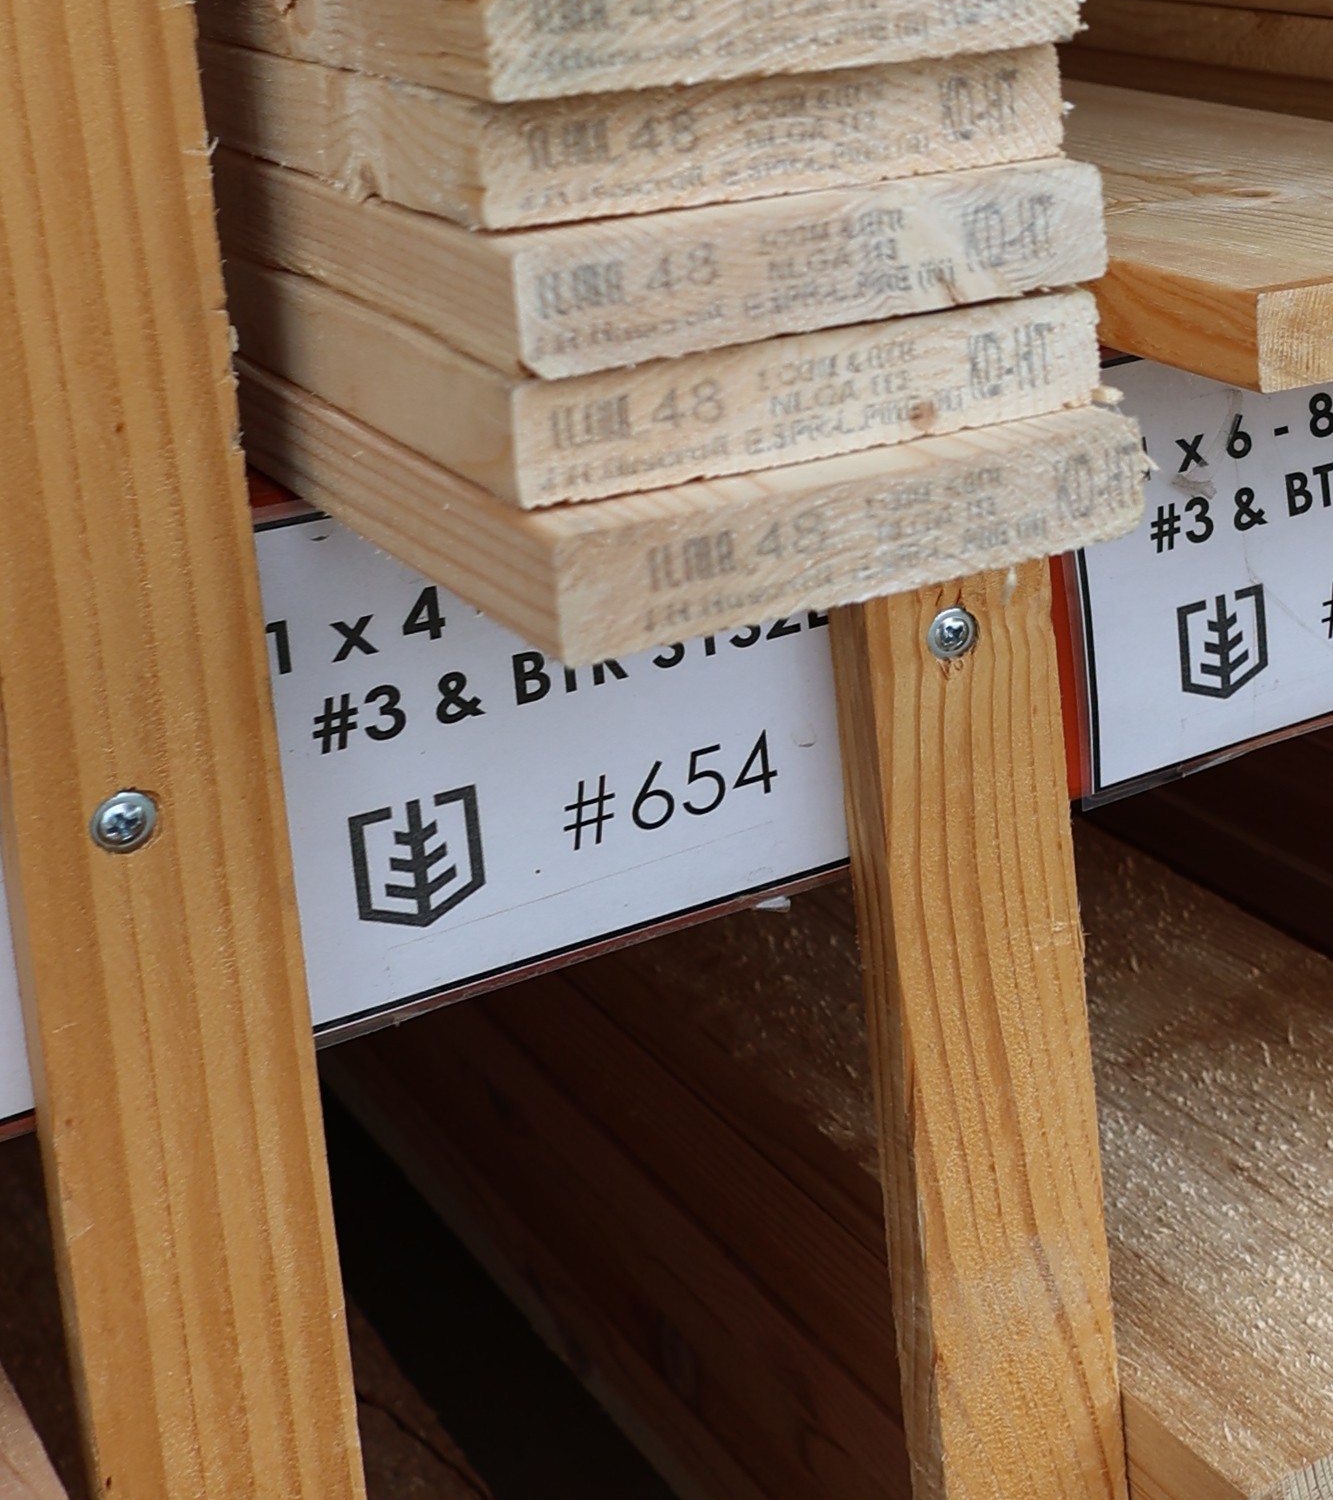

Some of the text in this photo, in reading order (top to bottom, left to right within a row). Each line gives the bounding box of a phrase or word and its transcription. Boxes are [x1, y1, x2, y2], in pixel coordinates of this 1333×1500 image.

[1176, 432, 1210, 474] x
[1226, 411, 1253, 461] 6
[1149, 495, 1216, 554] #3
[1233, 483, 1268, 532] &
[264, 585, 446, 676] 1 x 4
[312, 683, 407, 755] #3
[435, 670, 487, 725] &
[563, 729, 778, 851] #654
